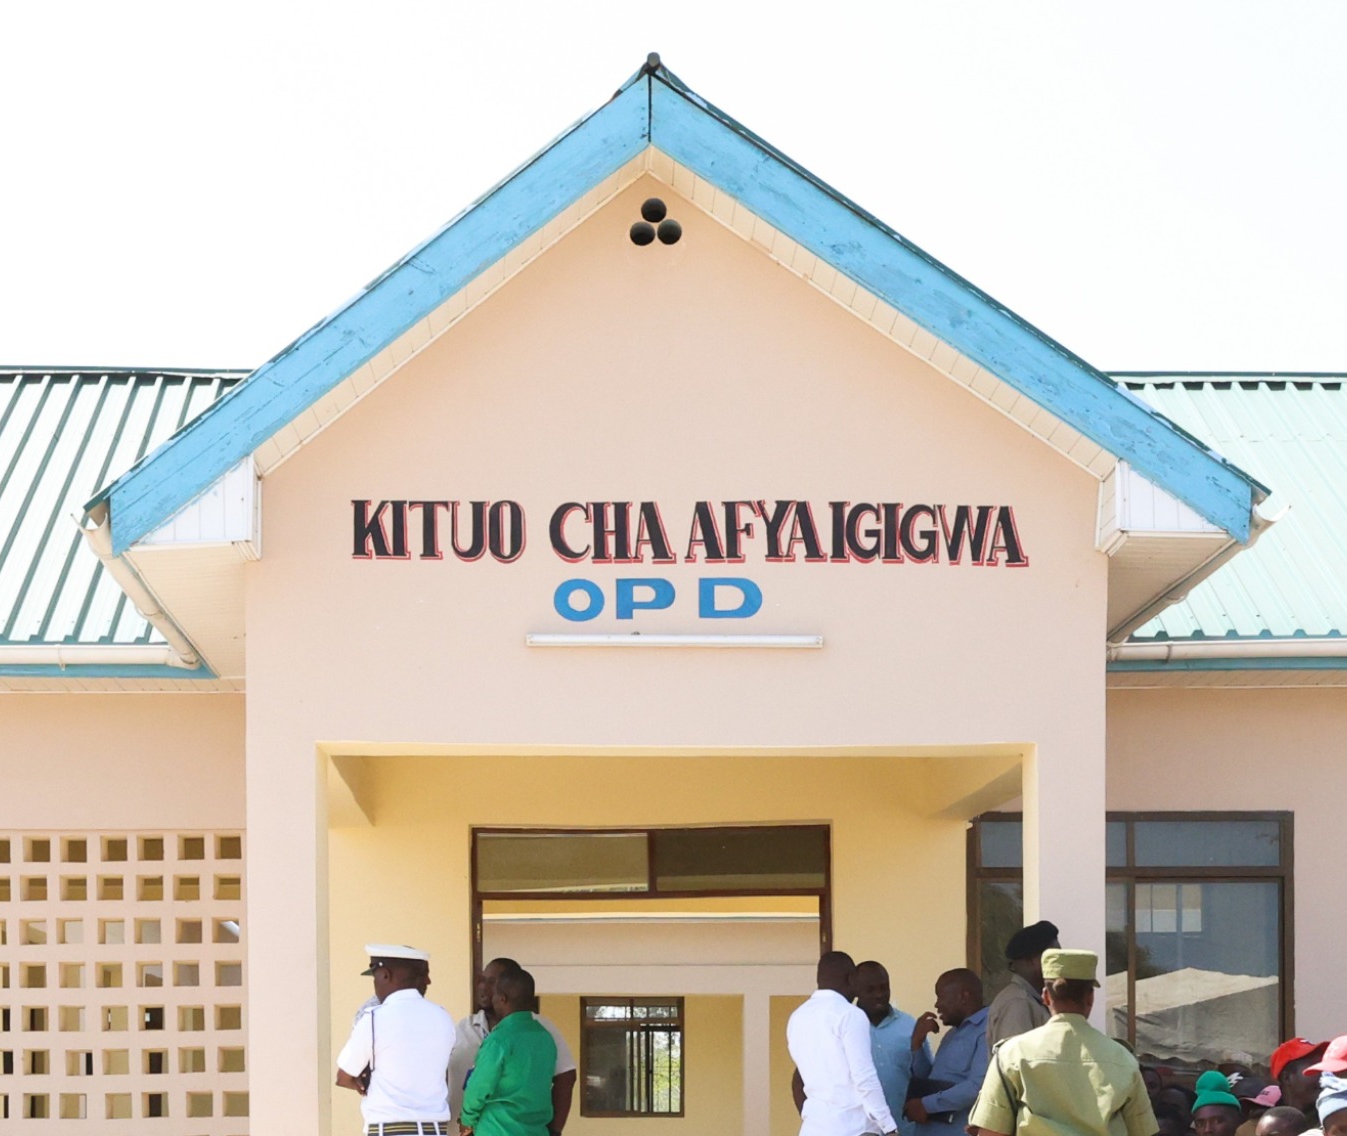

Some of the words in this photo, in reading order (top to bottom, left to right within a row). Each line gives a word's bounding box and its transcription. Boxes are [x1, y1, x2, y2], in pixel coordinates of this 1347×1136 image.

[351, 499, 527, 564] KITUO
[549, 500, 677, 564] CHA
[684, 500, 827, 564] AFYA
[828, 501, 1030, 567] IGIGWA
